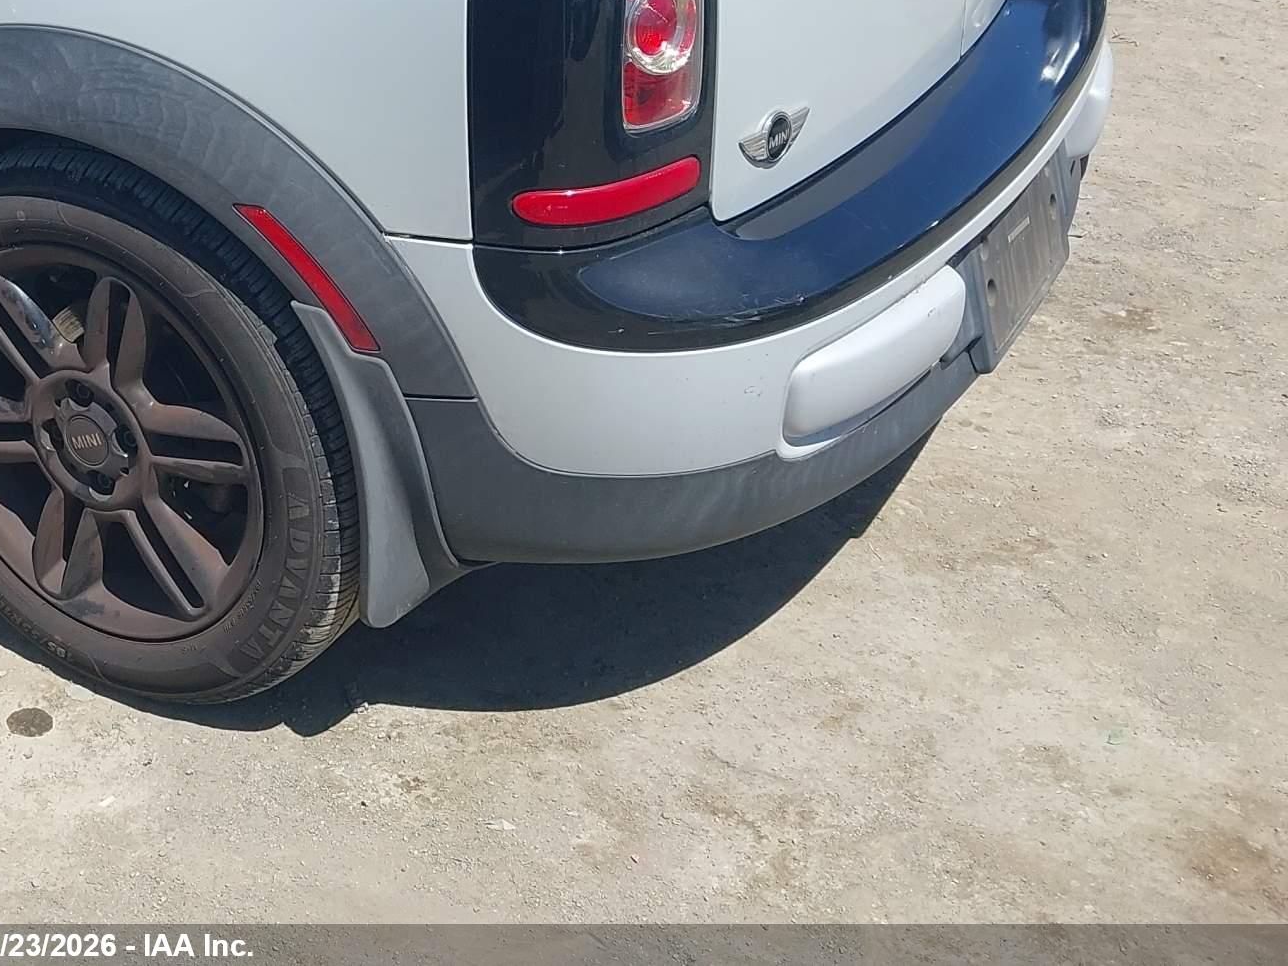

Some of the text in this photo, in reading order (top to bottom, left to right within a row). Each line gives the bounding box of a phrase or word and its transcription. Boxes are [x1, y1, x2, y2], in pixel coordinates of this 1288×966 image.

[768, 128, 791, 149] MINI
[71, 432, 103, 450] MINI
[239, 492, 313, 662] ADVANTA
